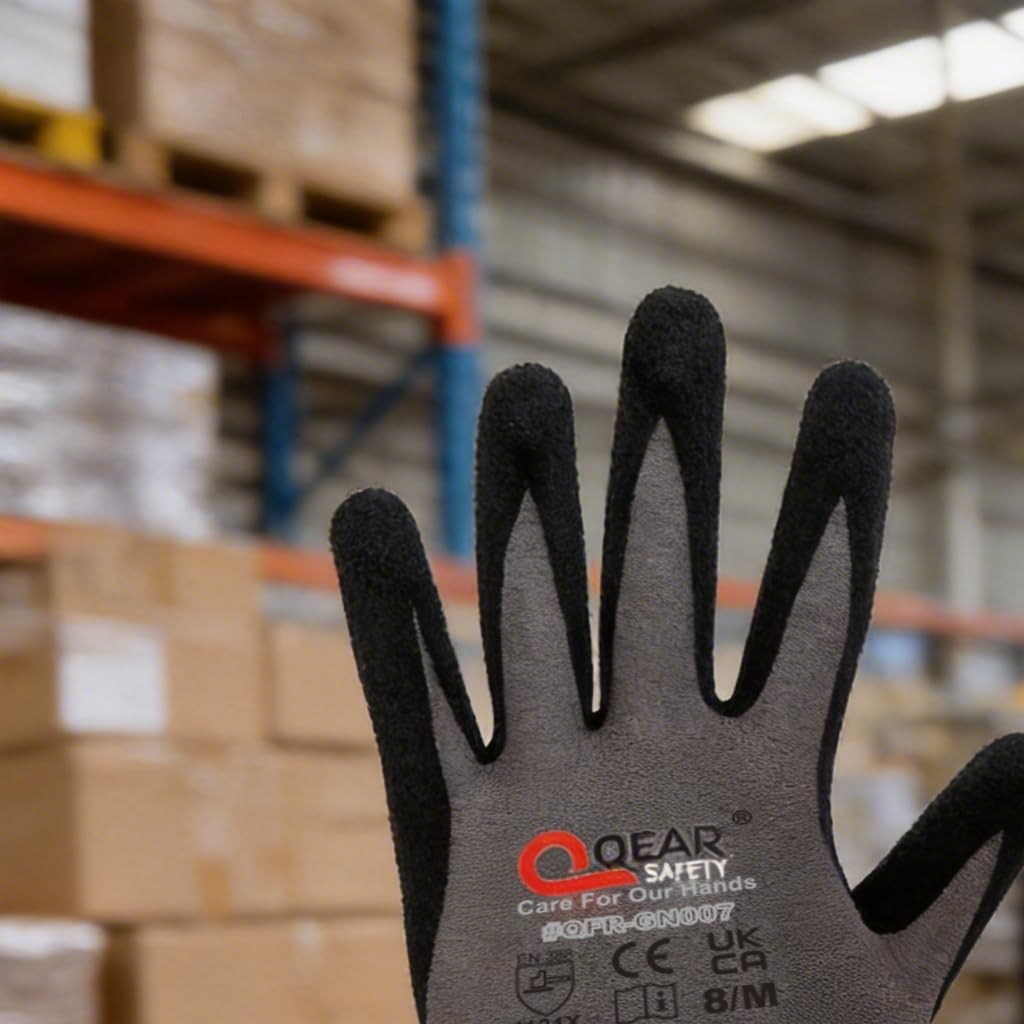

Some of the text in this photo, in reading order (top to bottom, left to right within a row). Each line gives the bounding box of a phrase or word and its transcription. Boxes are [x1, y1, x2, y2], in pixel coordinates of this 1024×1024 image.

[644, 859, 728, 883] SAFETY
[517, 875, 757, 916] Care For Our Hands
[708, 927, 764, 951] UK
[612, 938, 674, 978] CE
[711, 950, 768, 975] CA
[703, 982, 778, 1014] 8/M
